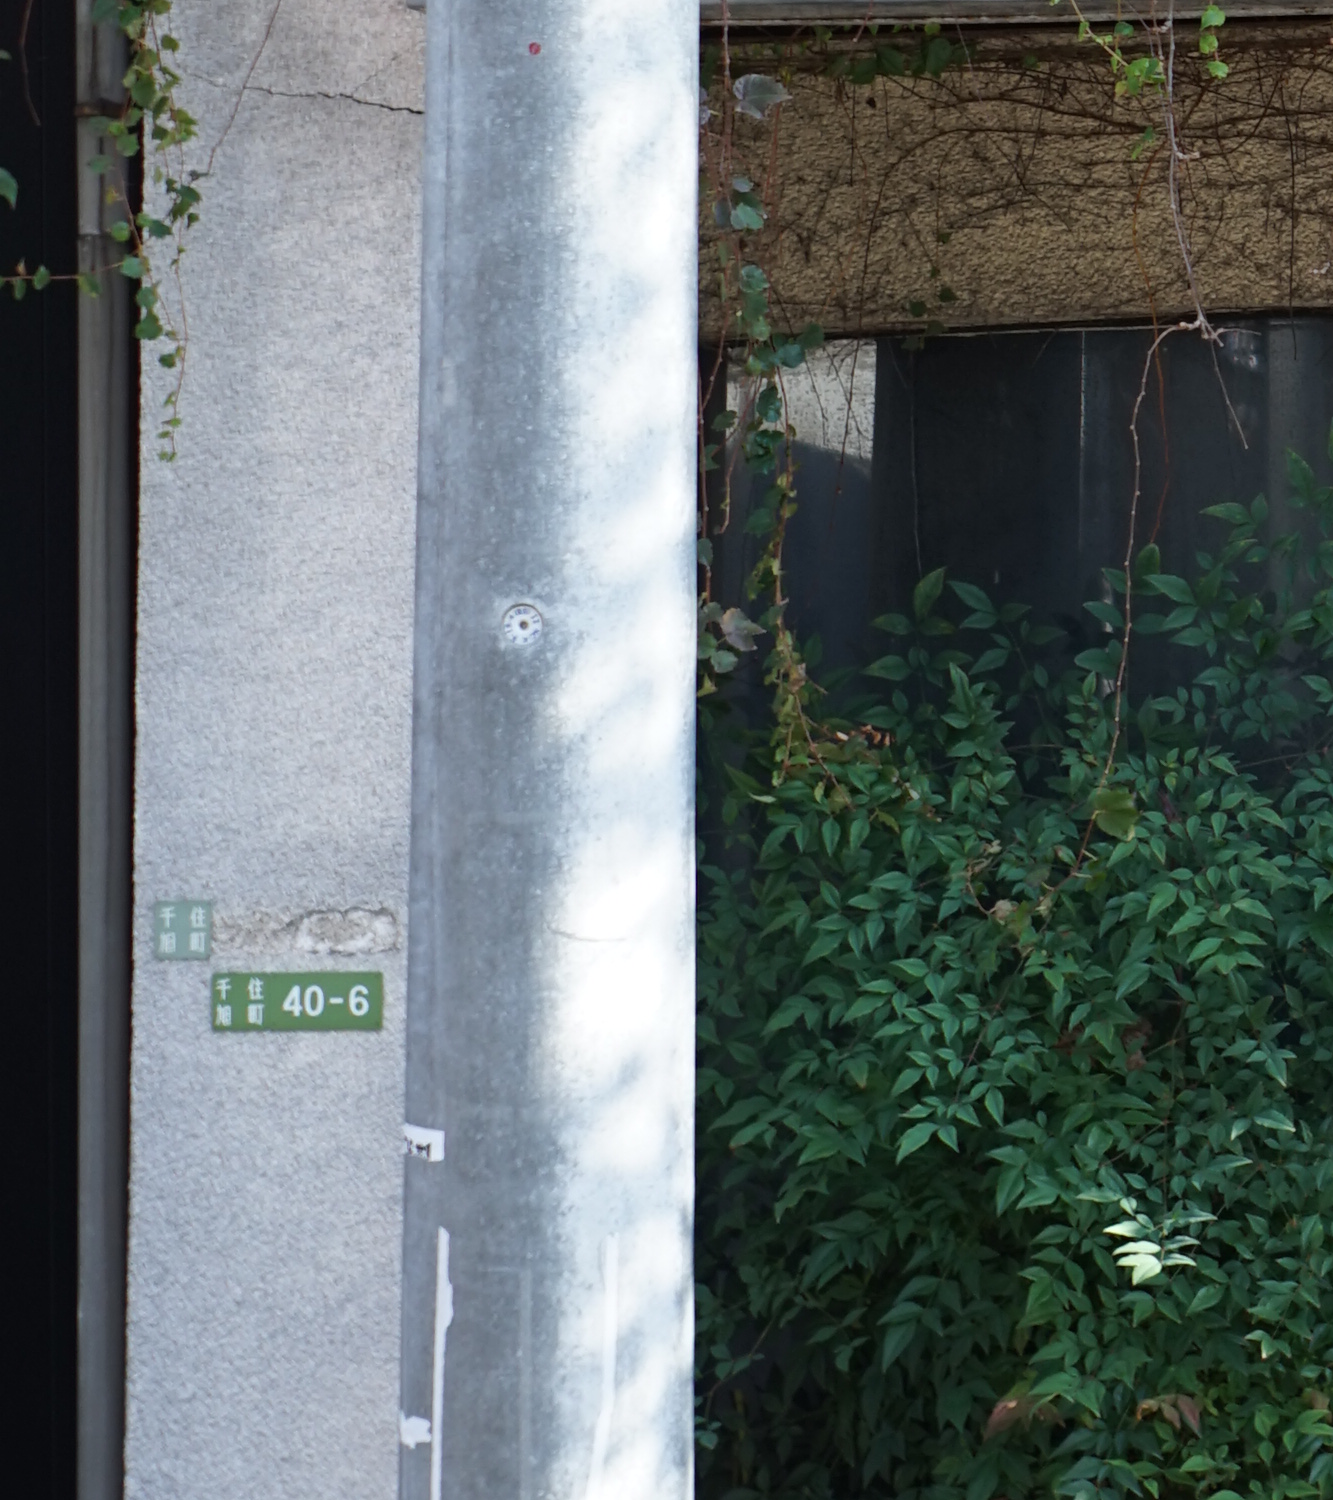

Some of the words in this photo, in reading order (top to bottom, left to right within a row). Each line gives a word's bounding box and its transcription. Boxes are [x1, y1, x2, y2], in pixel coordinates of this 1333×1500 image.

[159, 906, 207, 928] 千住
[214, 977, 265, 1001] 千住
[282, 984, 370, 1018] 40-6
[214, 1003, 265, 1027] 旭町
